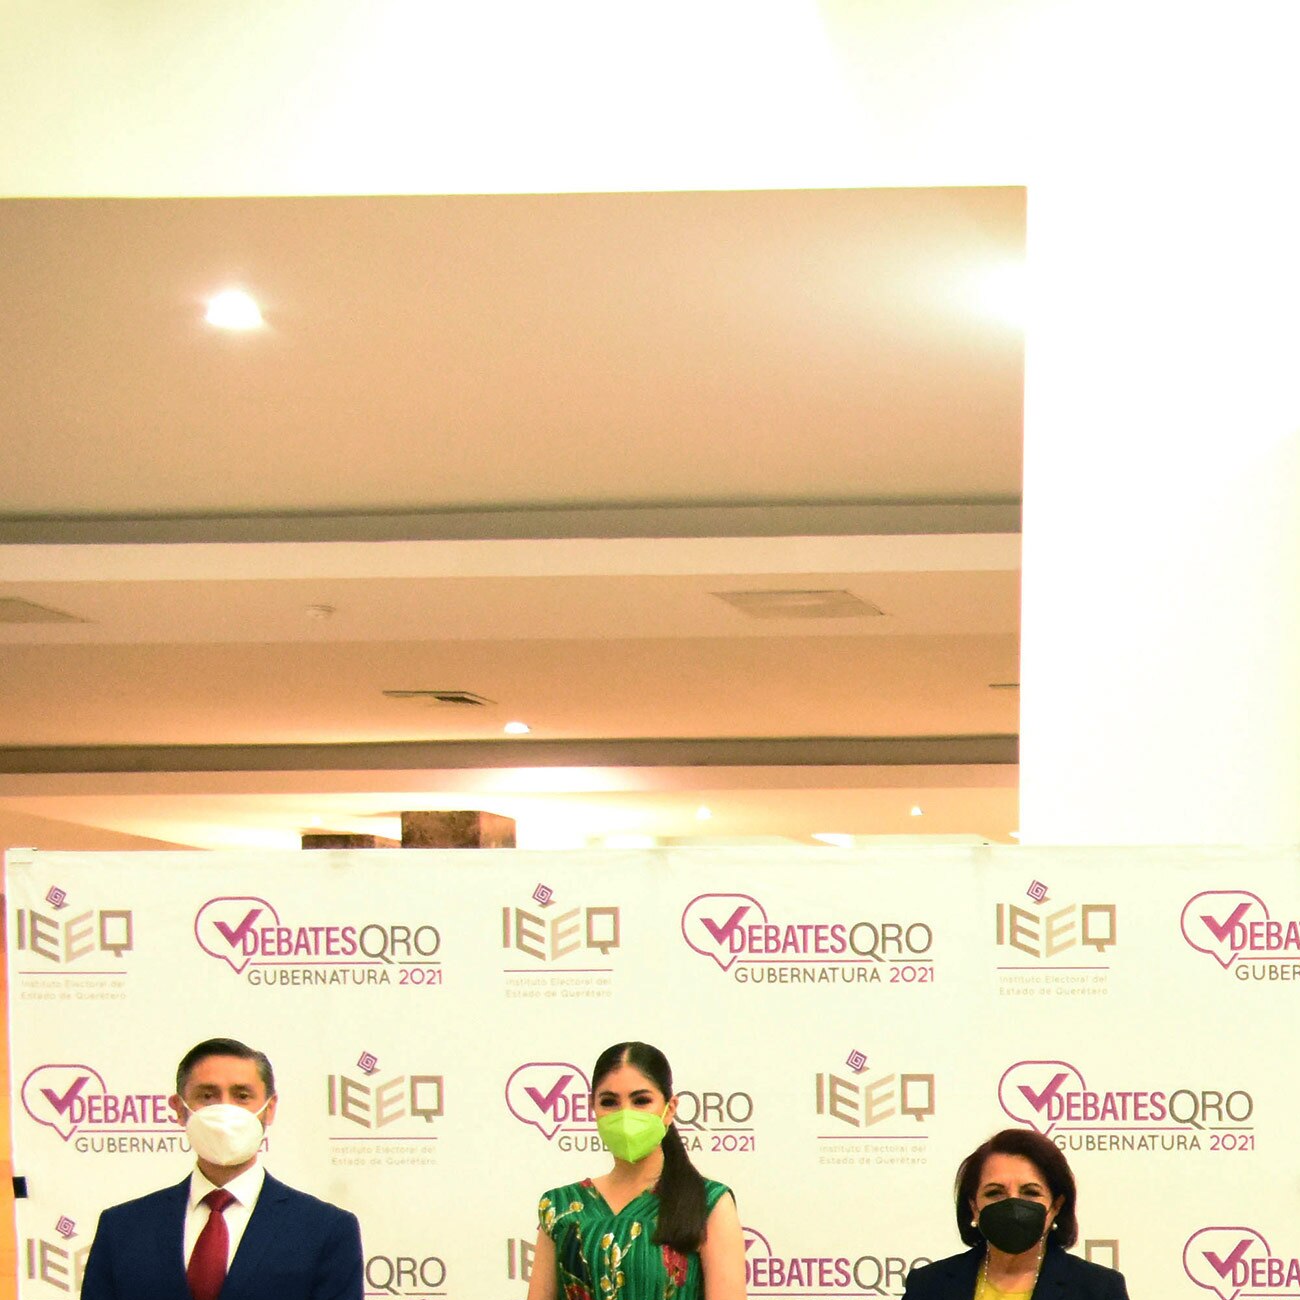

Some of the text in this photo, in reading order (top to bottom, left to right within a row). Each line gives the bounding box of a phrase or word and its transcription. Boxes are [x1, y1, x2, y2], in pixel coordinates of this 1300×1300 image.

[16, 906, 134, 965] IEEQ
[247, 969, 442, 986] GUBERNATURA 2021
[816, 1071, 935, 1128] IEEQ
[1052, 1133, 1256, 1152] GUBERNATURA 2021
